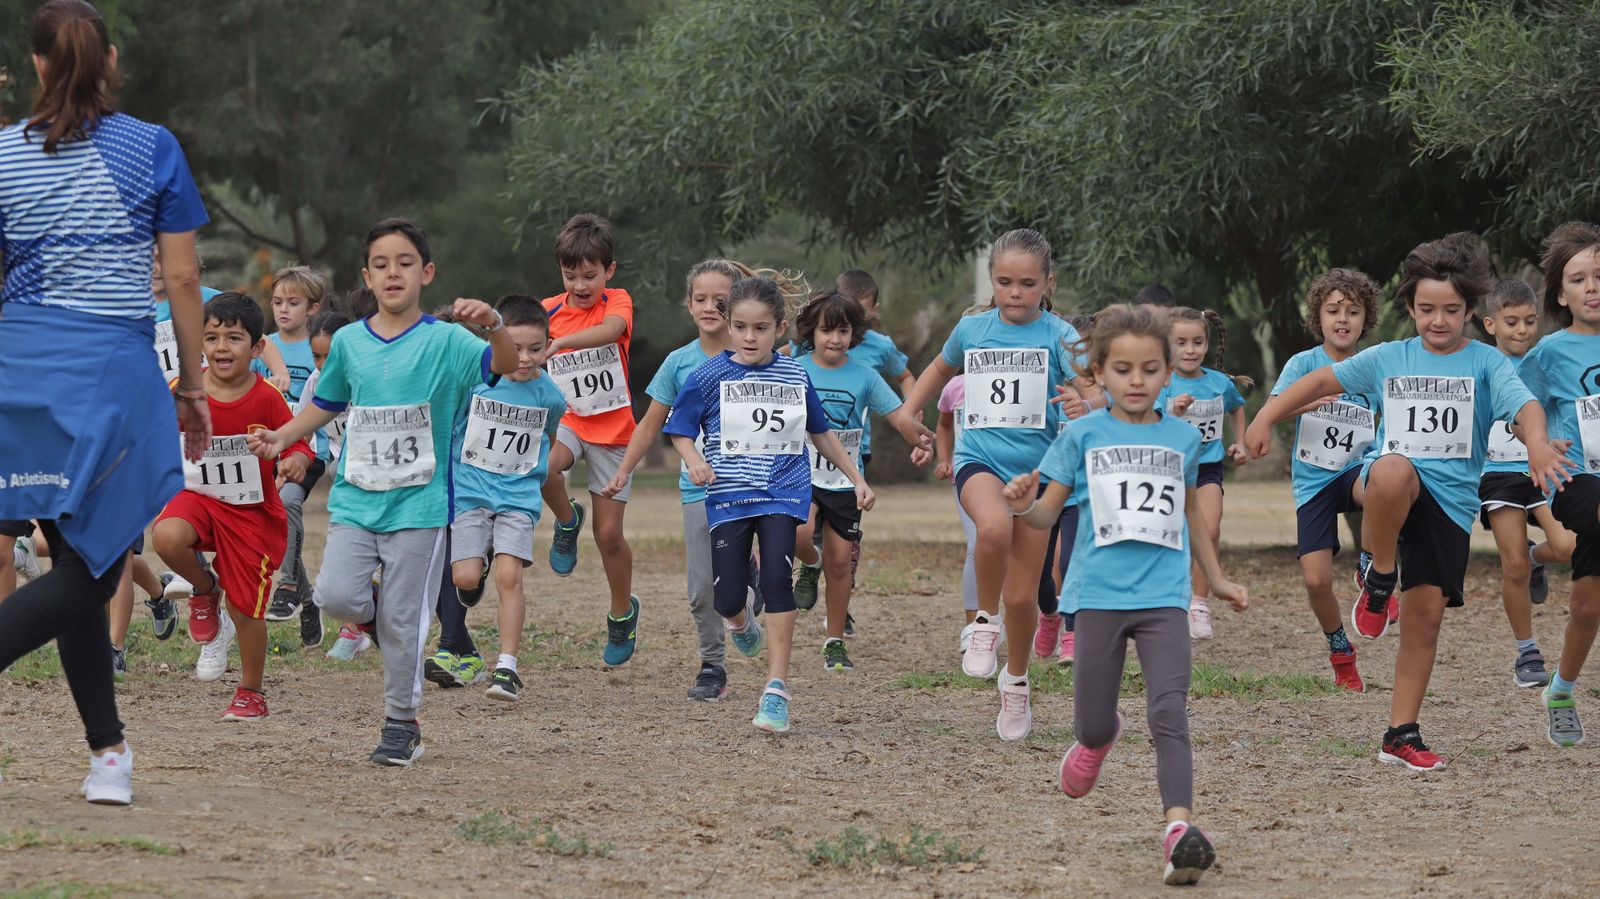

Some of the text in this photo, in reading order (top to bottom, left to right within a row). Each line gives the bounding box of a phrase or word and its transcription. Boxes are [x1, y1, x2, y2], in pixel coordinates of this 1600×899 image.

[562, 346, 616, 368] MILLA
[981, 351, 1043, 367] MILLA
[569, 370, 614, 399] 190
[740, 382, 800, 400] MILLA
[990, 378, 1022, 405] 81
[1403, 376, 1469, 394] MILLA
[486, 401, 543, 423] MILLA
[752, 407, 786, 433] 95
[1319, 402, 1372, 423] MILLA
[1405, 405, 1459, 434] 130
[204, 438, 249, 451] ILLA
[367, 435, 419, 466] 143
[484, 427, 531, 456] 170
[1323, 426, 1354, 453] 84
[1111, 447, 1181, 470] MILLA
[198, 461, 247, 485] 111
[1115, 480, 1176, 516] 125
